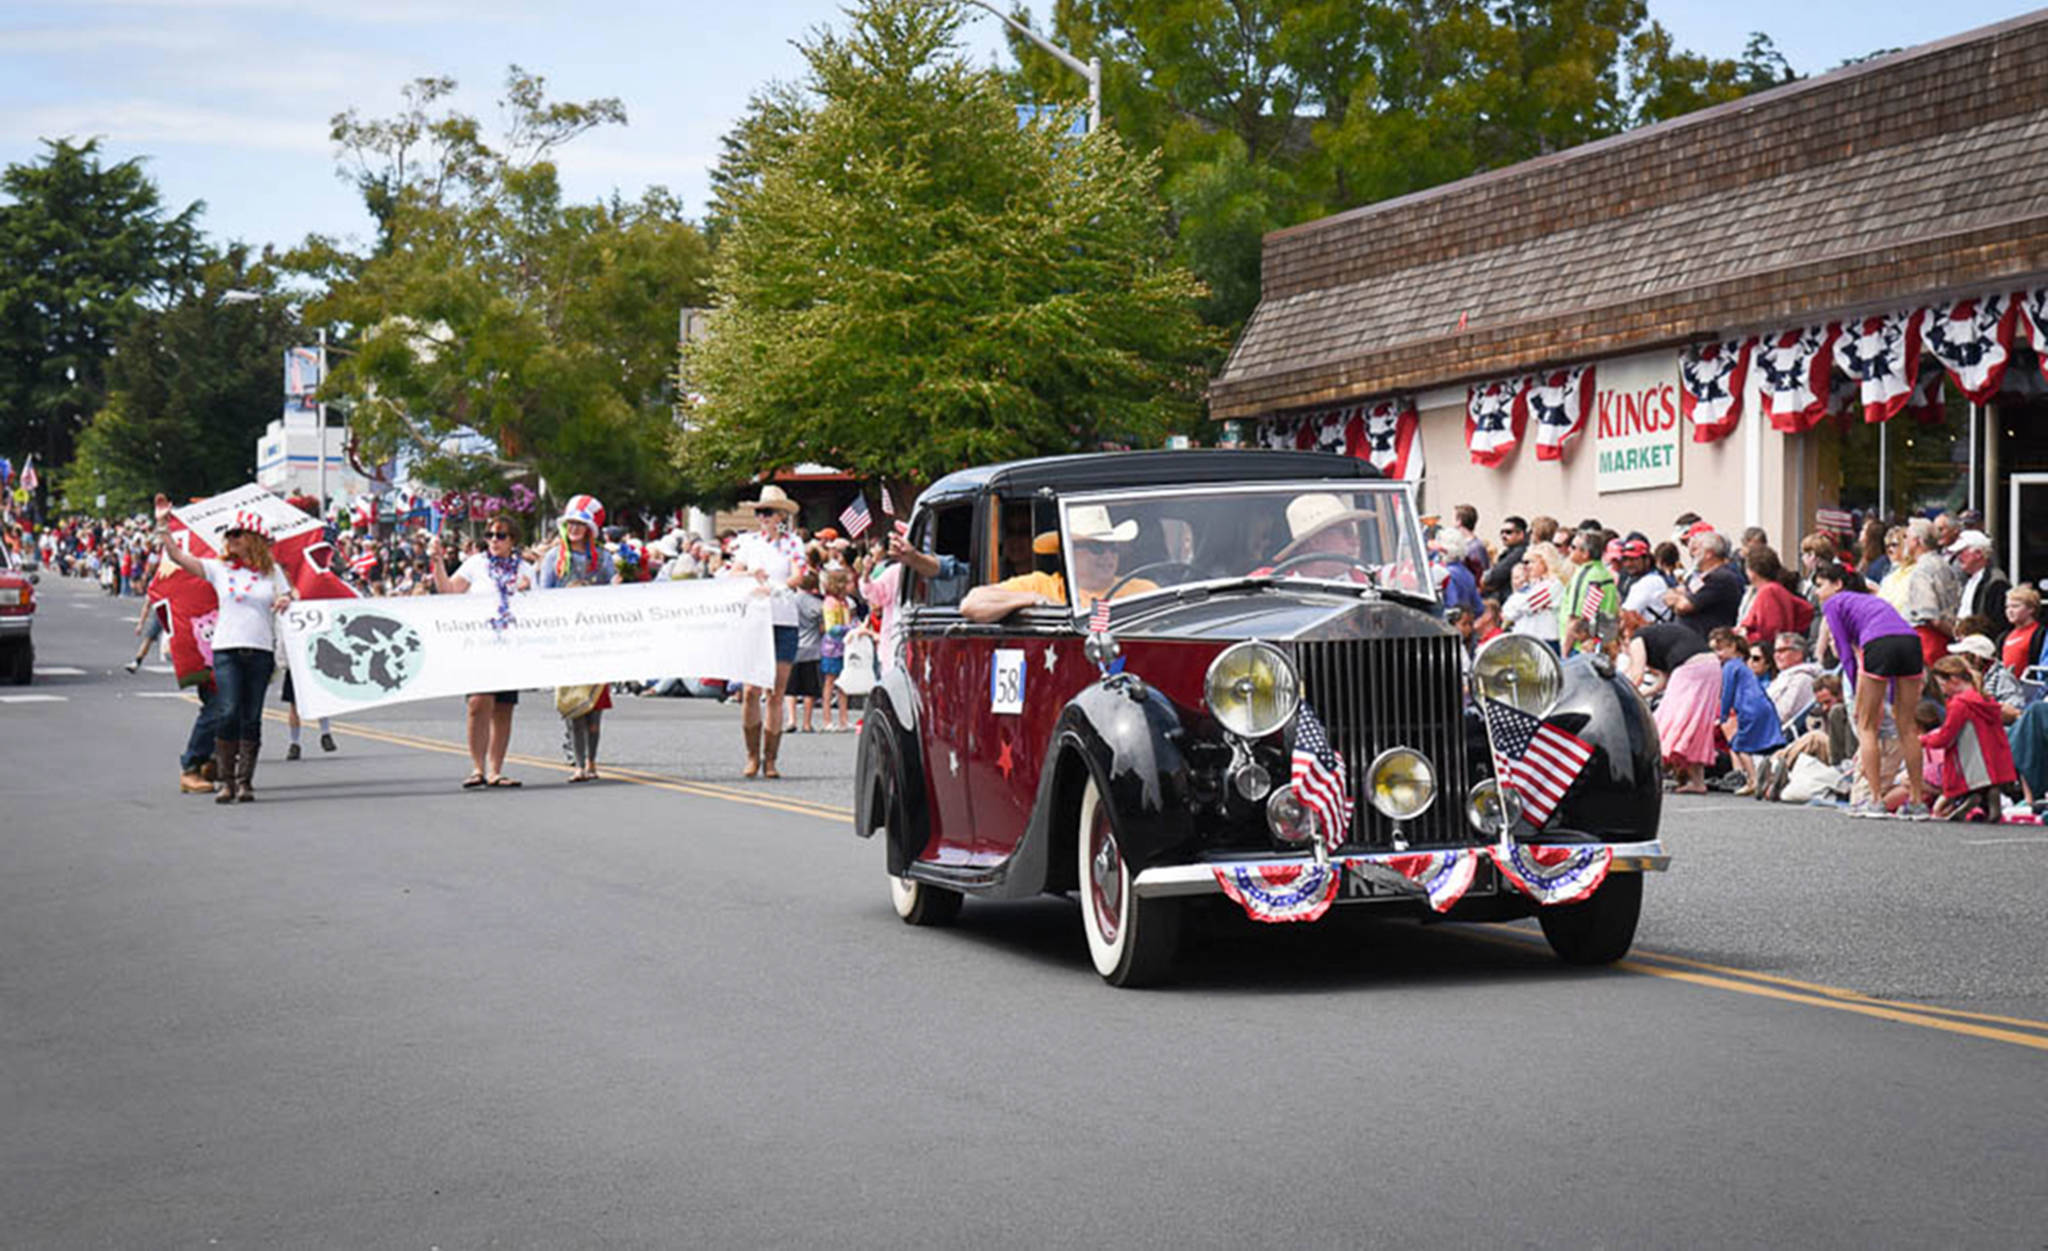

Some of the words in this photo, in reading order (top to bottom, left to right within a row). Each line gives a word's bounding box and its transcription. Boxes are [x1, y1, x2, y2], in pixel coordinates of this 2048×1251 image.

[1598, 382, 1675, 440] KING'S
[1599, 444, 1674, 474] MARKET
[290, 608, 323, 632] 59
[575, 605, 643, 626] Animal
[649, 600, 749, 621] Sanctuary
[998, 667, 1019, 703] 58
